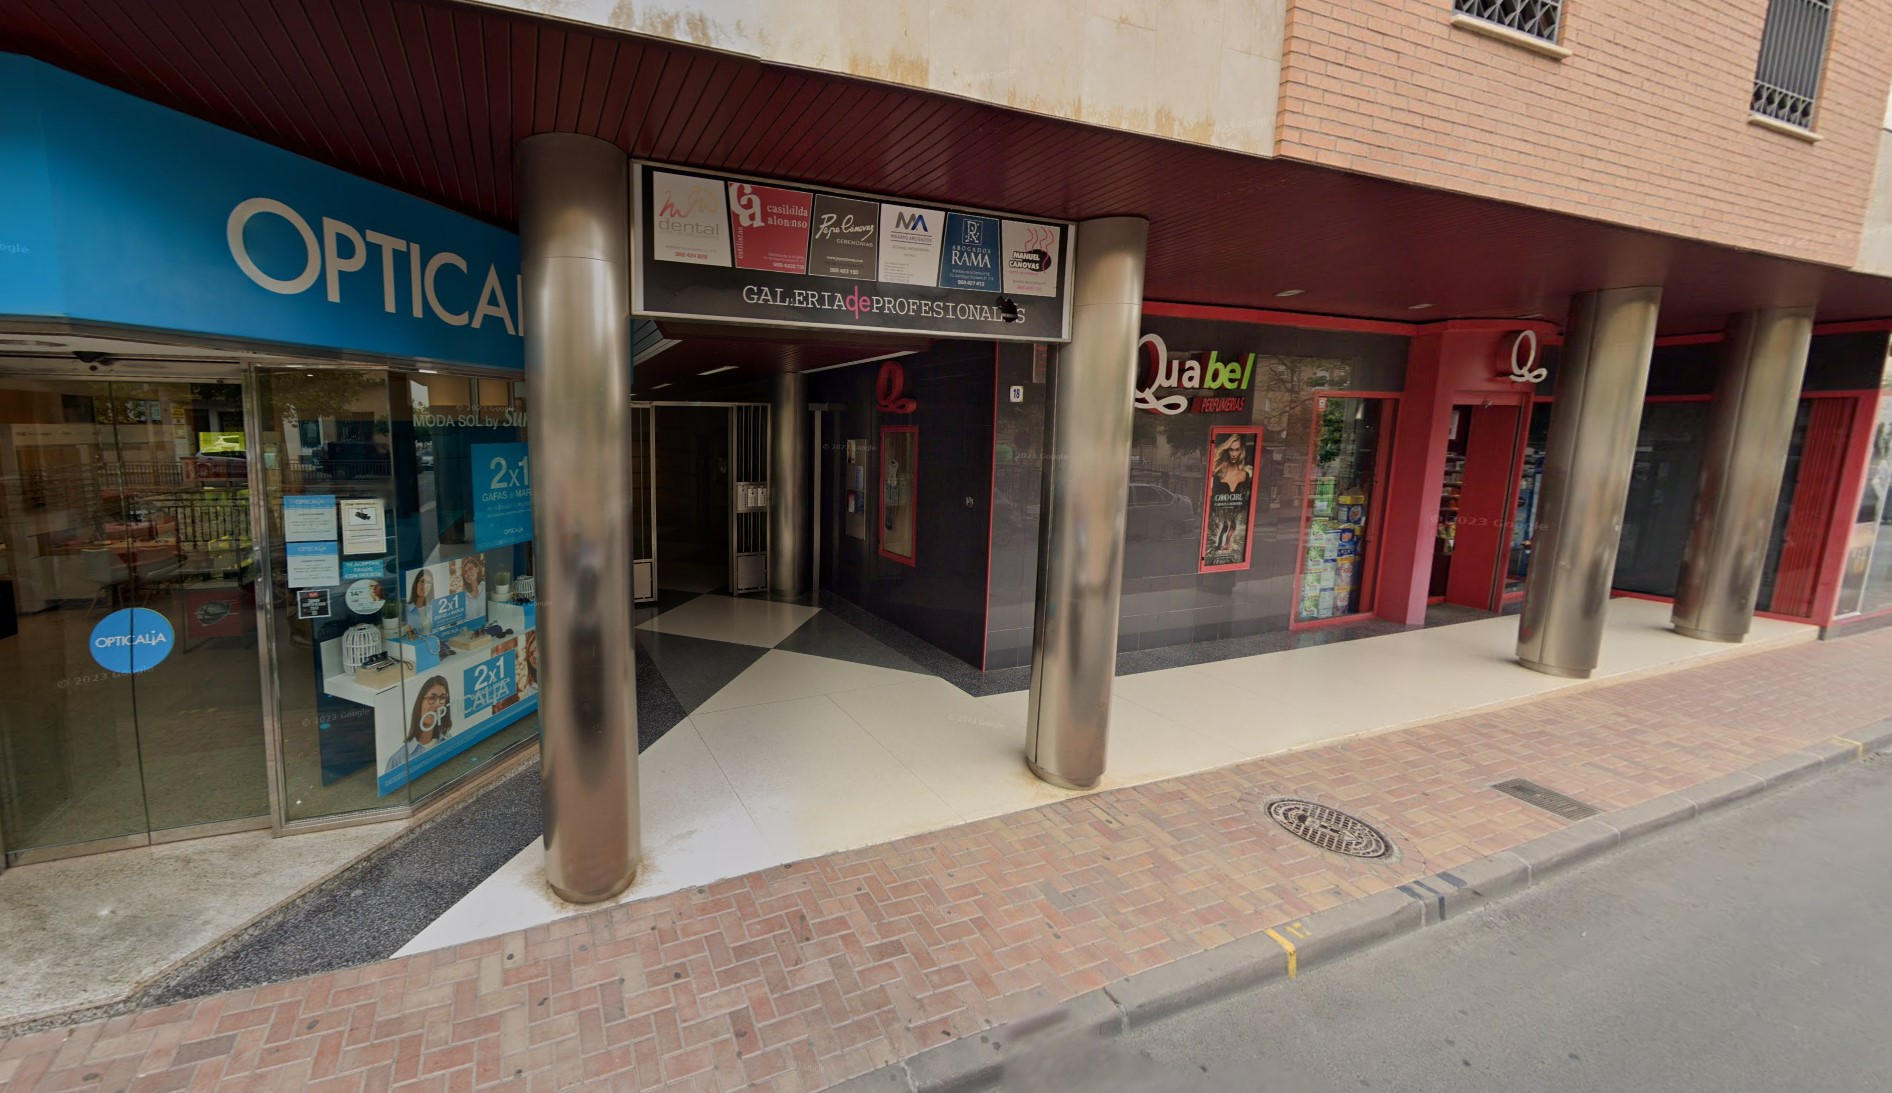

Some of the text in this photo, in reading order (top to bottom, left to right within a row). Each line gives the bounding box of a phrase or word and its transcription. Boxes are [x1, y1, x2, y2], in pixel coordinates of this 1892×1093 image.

[658, 217, 720, 235] dental
[951, 250, 991, 268] RAMA
[1012, 251, 1041, 261] MANUEL
[742, 284, 1026, 324] GALERIA de PROFESIONALS
[413, 414, 456, 427] MODA
[458, 414, 483, 427] SOL
[485, 415, 500, 430] by
[438, 595, 459, 614] 2x1
[474, 656, 505, 691] 2x1
